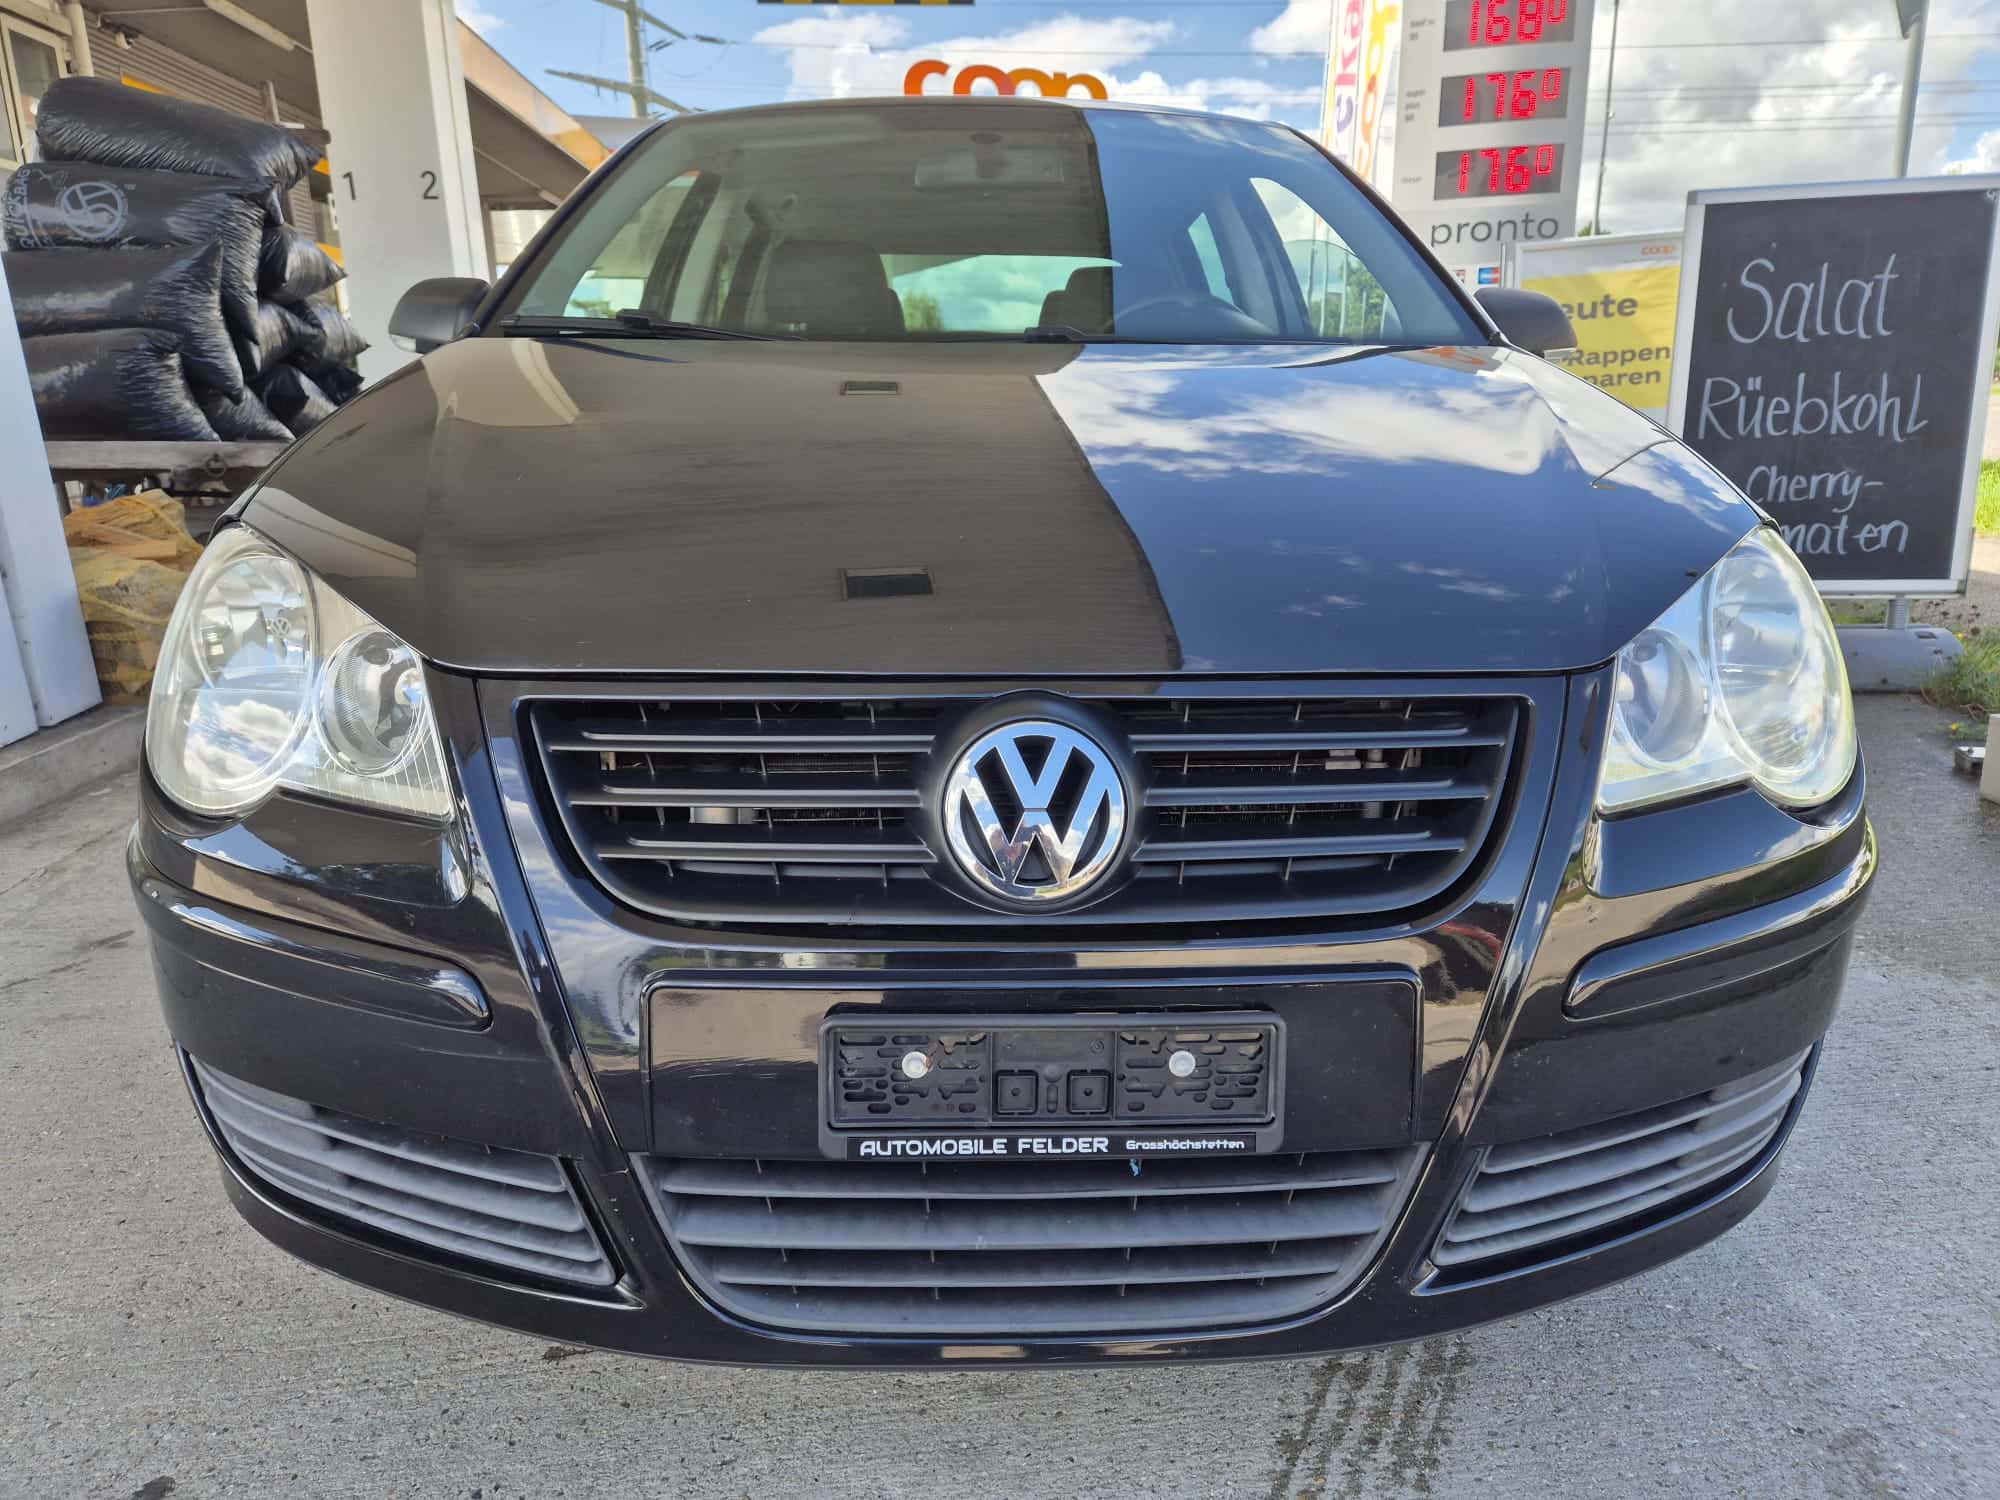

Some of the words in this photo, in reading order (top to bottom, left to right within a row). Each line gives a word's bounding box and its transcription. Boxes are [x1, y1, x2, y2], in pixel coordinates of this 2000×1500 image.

[1464, 68, 1562, 121] 1760
[342, 171, 357, 201] 1
[421, 170, 440, 200] 2
[1458, 144, 1555, 193] 1760
[1431, 212, 1560, 247] pronto
[1562, 294, 1639, 320] eute
[1726, 253, 1900, 344] Salat
[1697, 371, 1929, 442] Rüebkohl
[1782, 514, 1909, 555] maten
[859, 1138, 1008, 1157] AUTOMOBILE
[1017, 1136, 1109, 1154] FELDER
[1125, 1139, 1246, 1151] Grosshöchstetten
